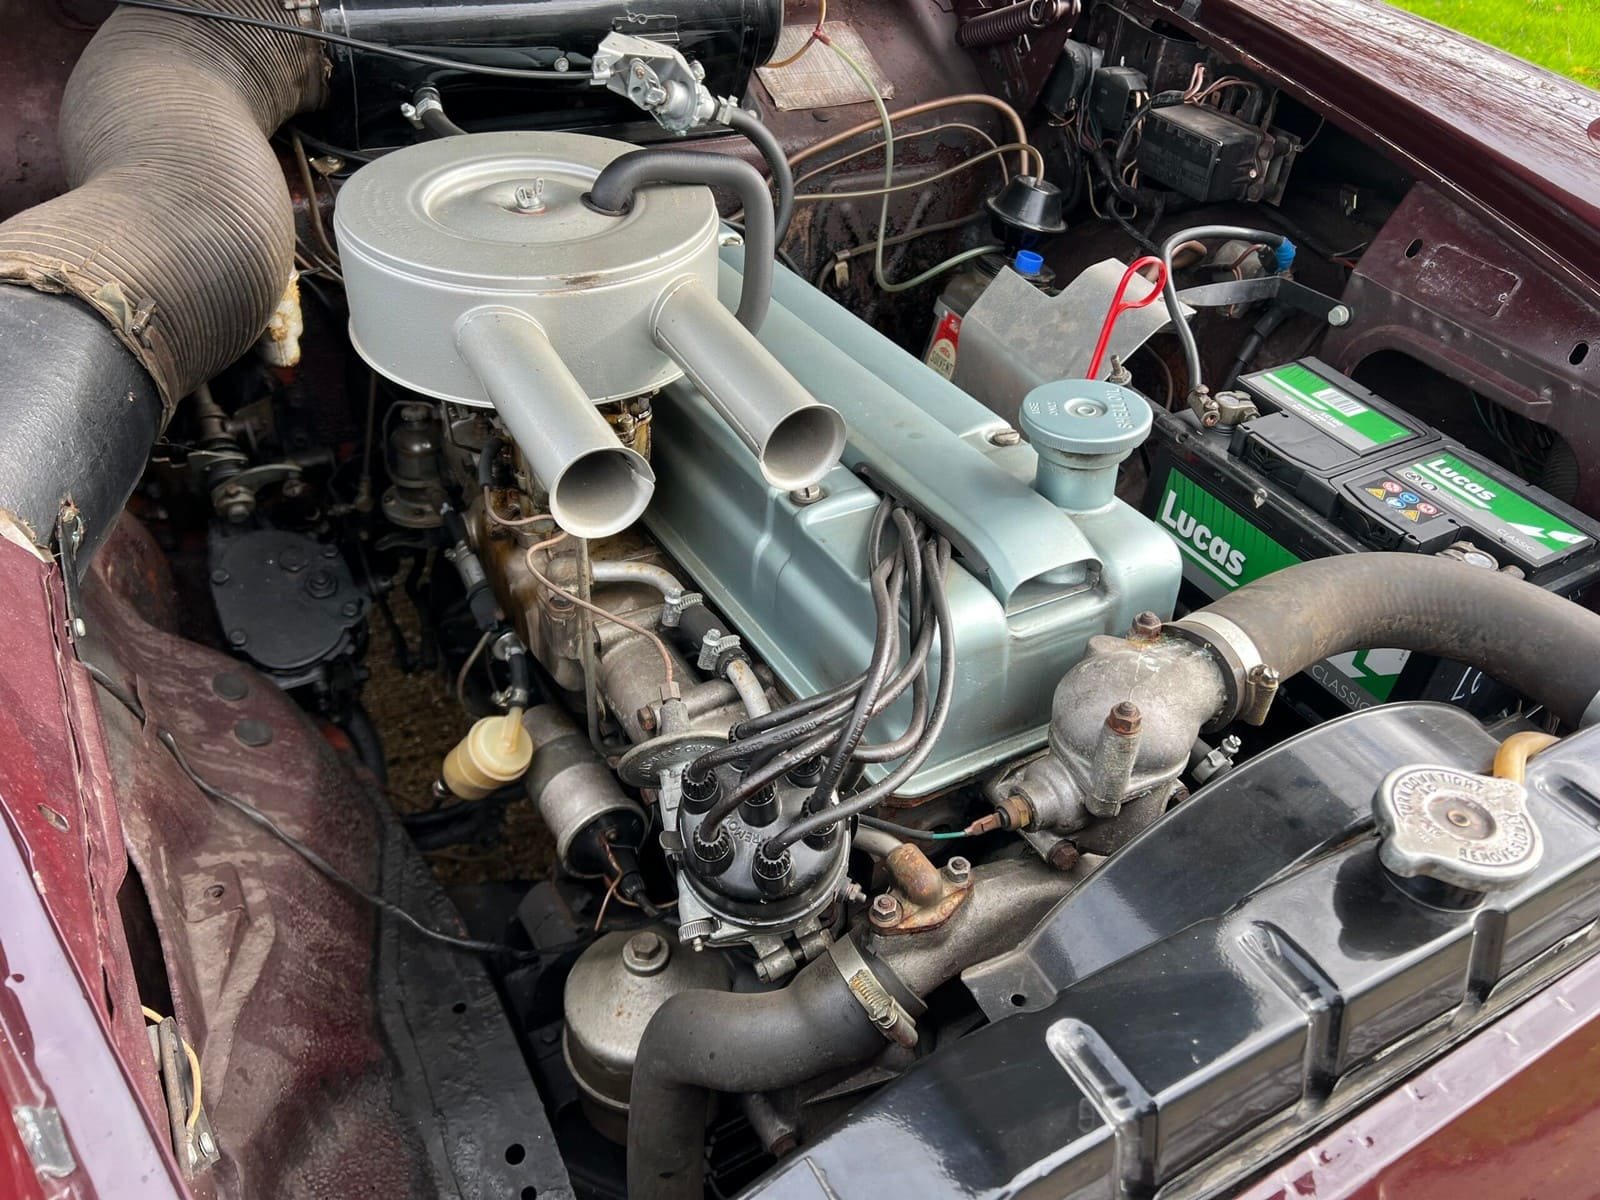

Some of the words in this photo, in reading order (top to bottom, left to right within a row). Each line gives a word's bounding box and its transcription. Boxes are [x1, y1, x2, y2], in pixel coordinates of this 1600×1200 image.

[930, 351, 954, 373] SOLVENT
[1106, 387, 1124, 402] OIL
[1111, 402, 1135, 429] SHELL
[1426, 459, 1496, 501] Lucas
[1161, 489, 1246, 576] Lucas
[1497, 528, 1537, 553] CLASSIC
[1402, 773, 1436, 791] DOWN
[1438, 773, 1484, 792] TIGHT
[728, 819, 761, 844] REMO
[1459, 847, 1519, 863] REMOVE
